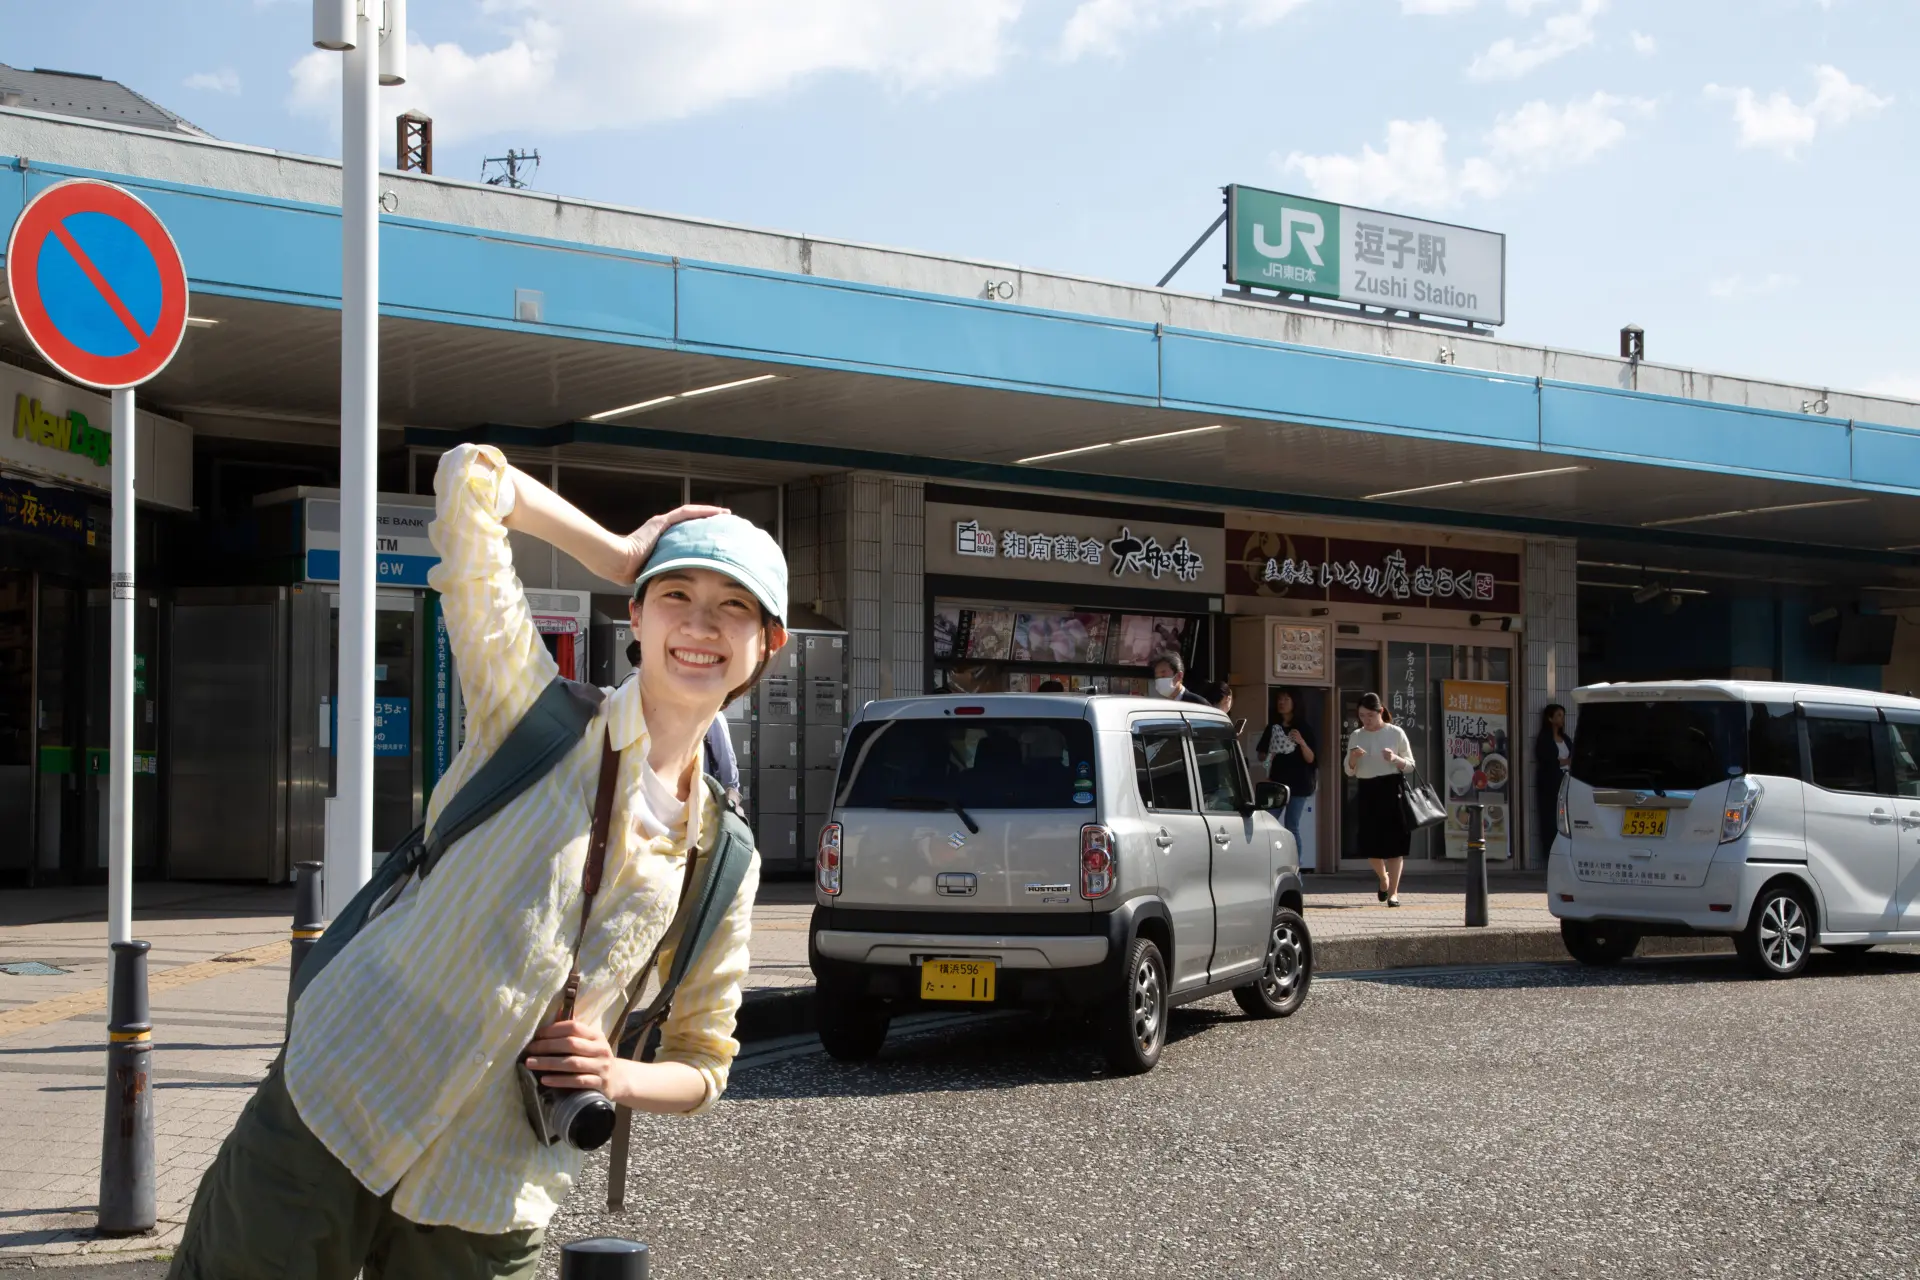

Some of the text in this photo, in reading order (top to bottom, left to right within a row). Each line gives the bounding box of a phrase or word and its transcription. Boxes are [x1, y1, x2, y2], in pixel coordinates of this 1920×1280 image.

[1253, 207, 1325, 266] JR
[1354, 221, 1447, 276] 逗子駅
[1262, 262, 1317, 283] JR東日本
[1354, 269, 1478, 310] Zushi Station
[17, 393, 112, 466] NewDay
[377, 516, 424, 527] RE BANK
[376, 538, 398, 551] TM
[1003, 526, 1203, 580] 湘南鎌倉 大船軒
[379, 560, 404, 576] ew
[1319, 548, 1474, 600] いろり庵きらく
[1404, 650, 1417, 729] 当店自慢の
[1446, 714, 1489, 738] 朝定食
[1446, 738, 1480, 757] 380円
[1630, 820, 1664, 835] 59-94
[1027, 885, 1069, 893] HUSTLER
[939, 963, 980, 975] 横浜596
